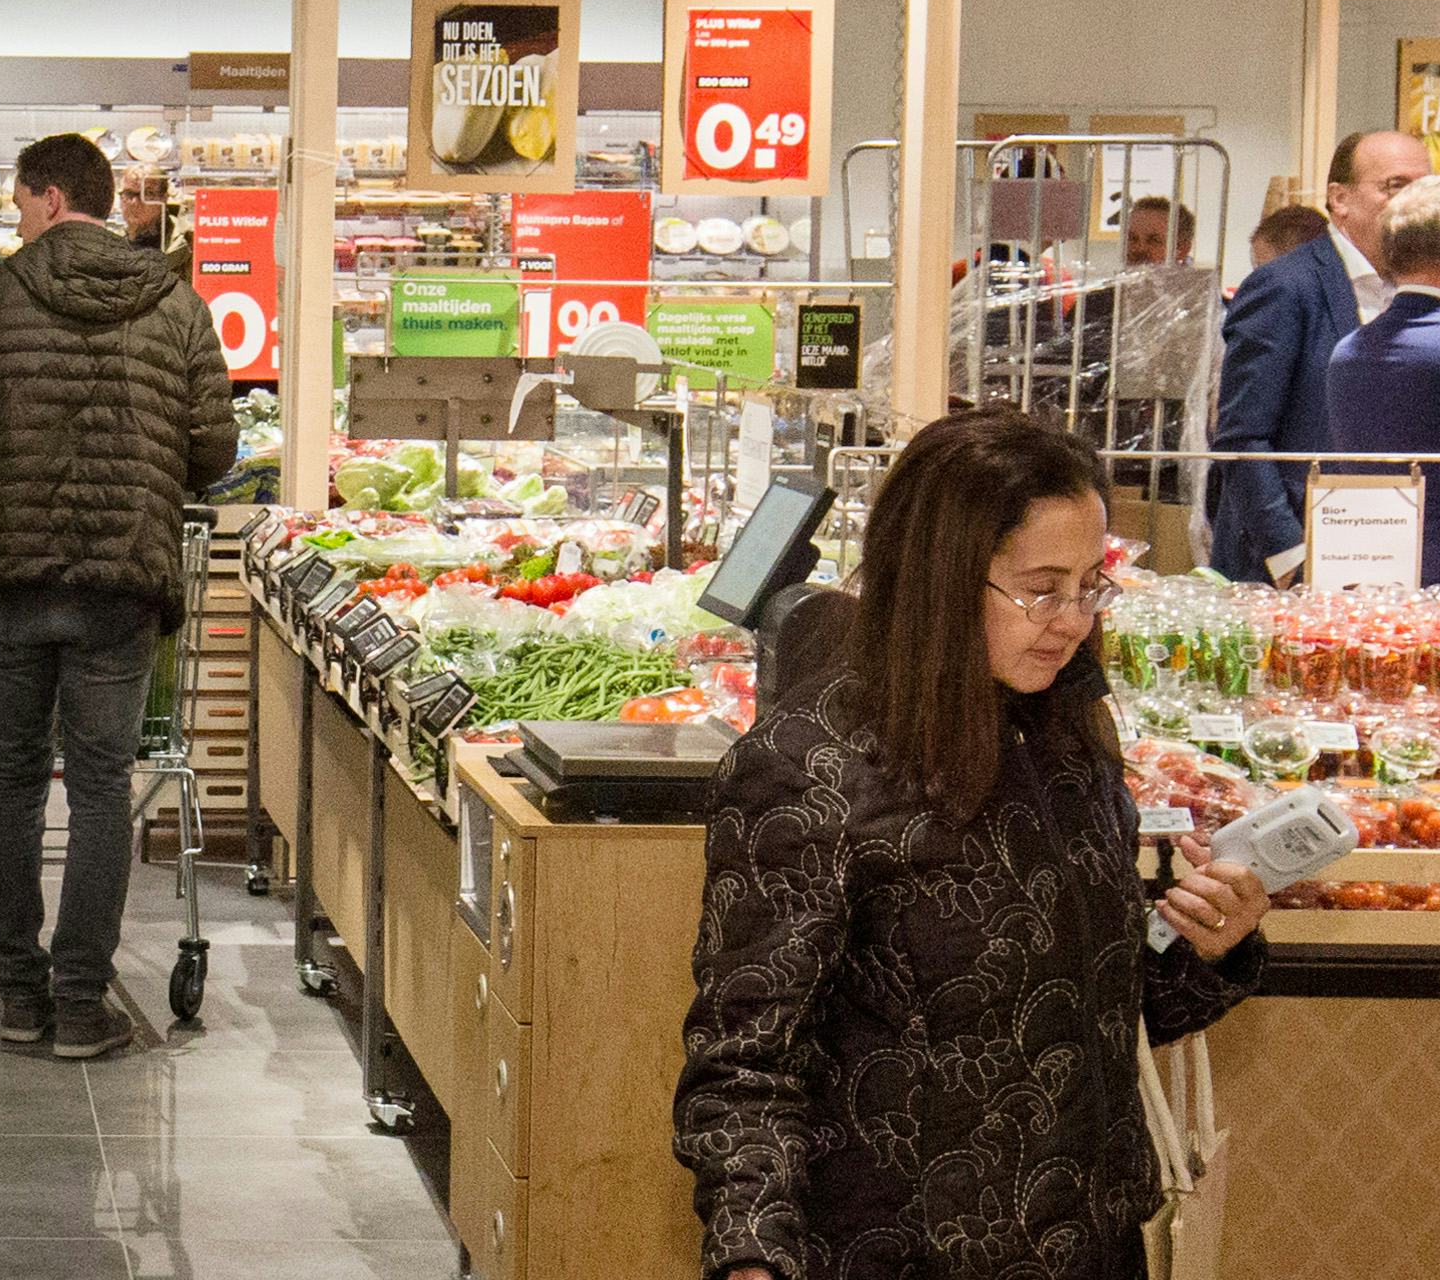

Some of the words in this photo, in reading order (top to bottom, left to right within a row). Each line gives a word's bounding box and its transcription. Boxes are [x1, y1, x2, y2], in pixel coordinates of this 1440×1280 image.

[695, 18, 724, 29] PLUS
[443, 21, 459, 41] NU
[463, 21, 497, 42] DOEN,
[443, 42, 461, 61] DIT
[466, 42, 476, 61] IS
[480, 42, 501, 61] HET
[220, 66, 285, 78] Maaltijden
[440, 64, 546, 106] SEIZOEN.
[698, 77, 718, 87] 500
[720, 77, 748, 87] GRAM
[695, 103, 806, 170] 0.49
[199, 217, 228, 227] PLUS
[232, 217, 268, 227] Witlof
[611, 214, 624, 225] of
[517, 226, 541, 237] pita
[202, 264, 220, 273] 500
[222, 264, 249, 273] GRAM
[403, 283, 446, 296] Onze
[403, 299, 491, 315] maaltijden
[403, 317, 442, 330] thuis
[448, 317, 508, 331] maken.
[658, 313, 712, 324] Dagelijks
[717, 314, 746, 322] verse
[657, 324, 723, 335] maaltijden,
[658, 336, 671, 345] en
[674, 334, 714, 345] salade
[717, 336, 739, 345] met
[695, 346, 719, 357] vind
[722, 346, 734, 359] je
[736, 346, 748, 357] in
[801, 345, 820, 356] DEZE
[1322, 507, 1347, 515] Bio+
[1322, 517, 1408, 527] Cherrytomaten
